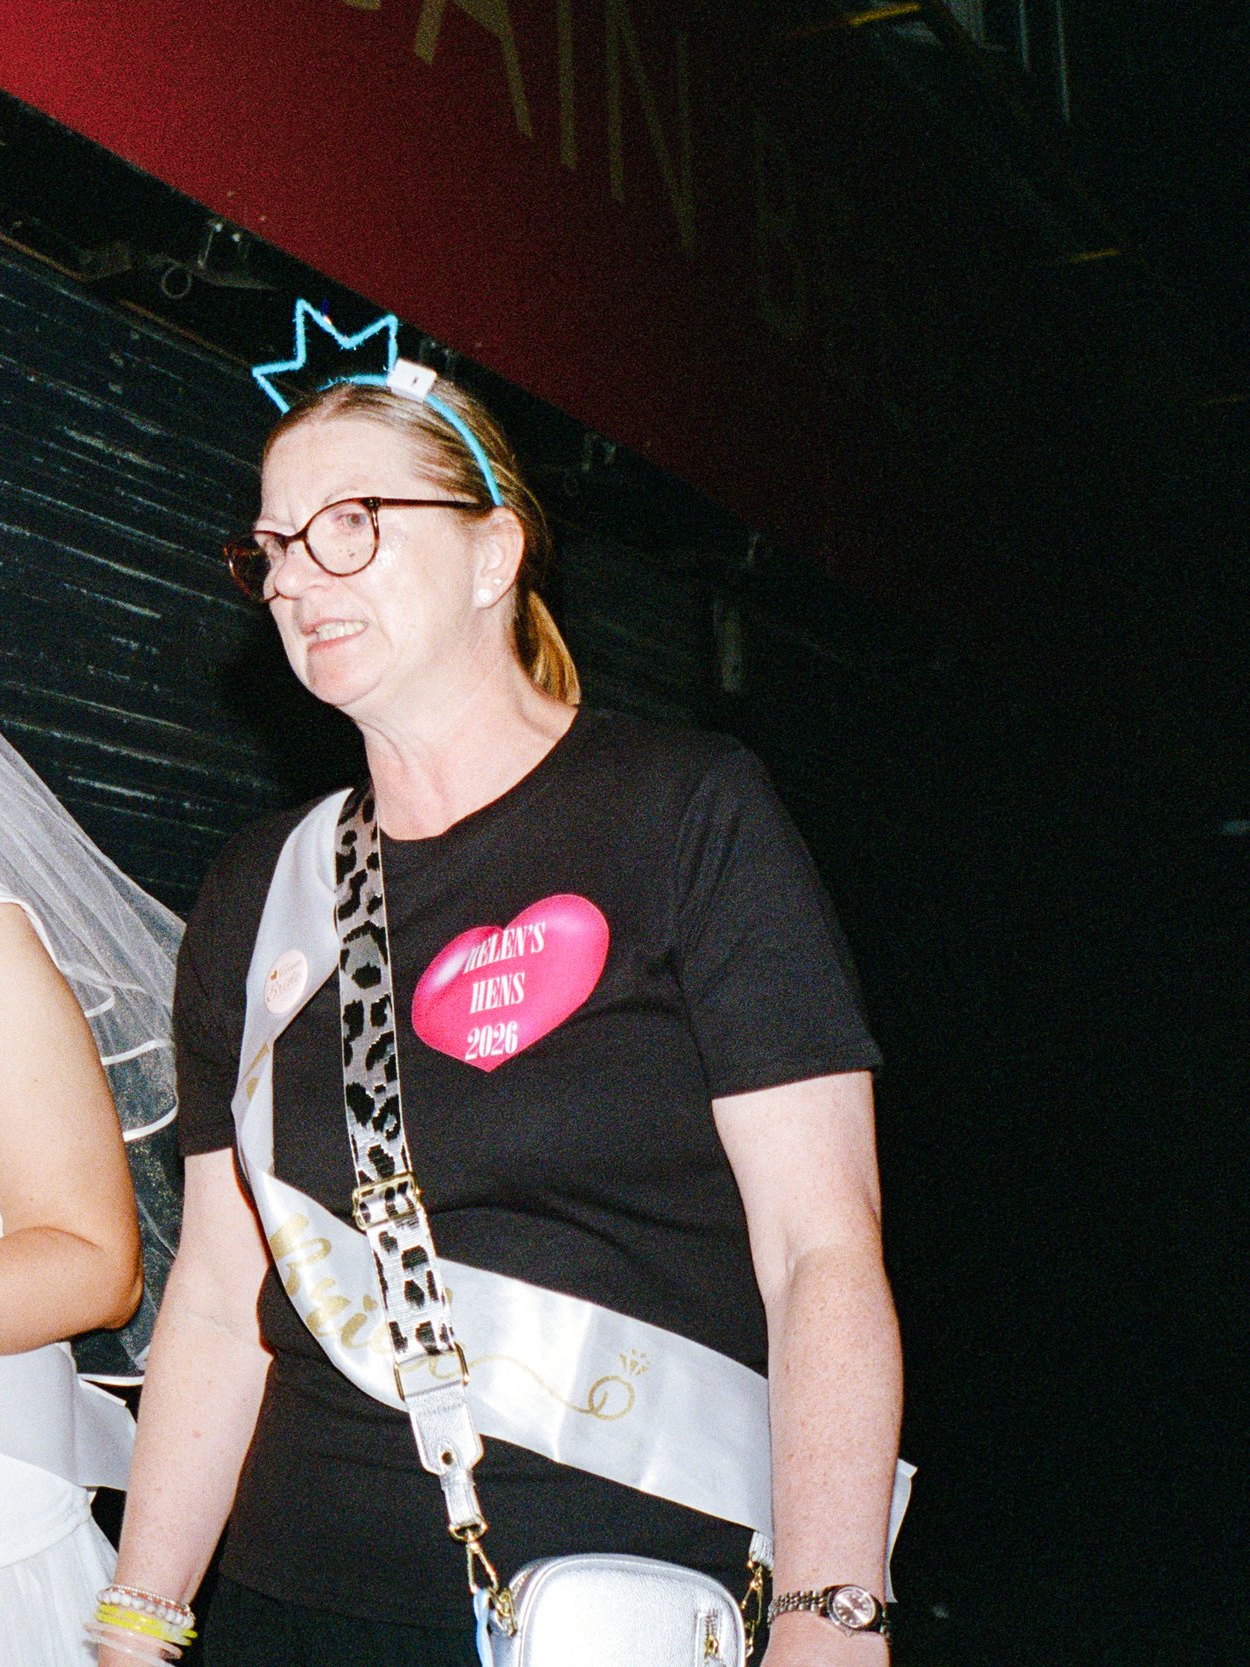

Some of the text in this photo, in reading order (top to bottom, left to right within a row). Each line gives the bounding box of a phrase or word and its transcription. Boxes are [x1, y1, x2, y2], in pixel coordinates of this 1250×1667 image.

[463, 920, 546, 974] HELEN'S
[470, 972, 526, 1015] HENS
[464, 1020, 519, 1061] 2026
